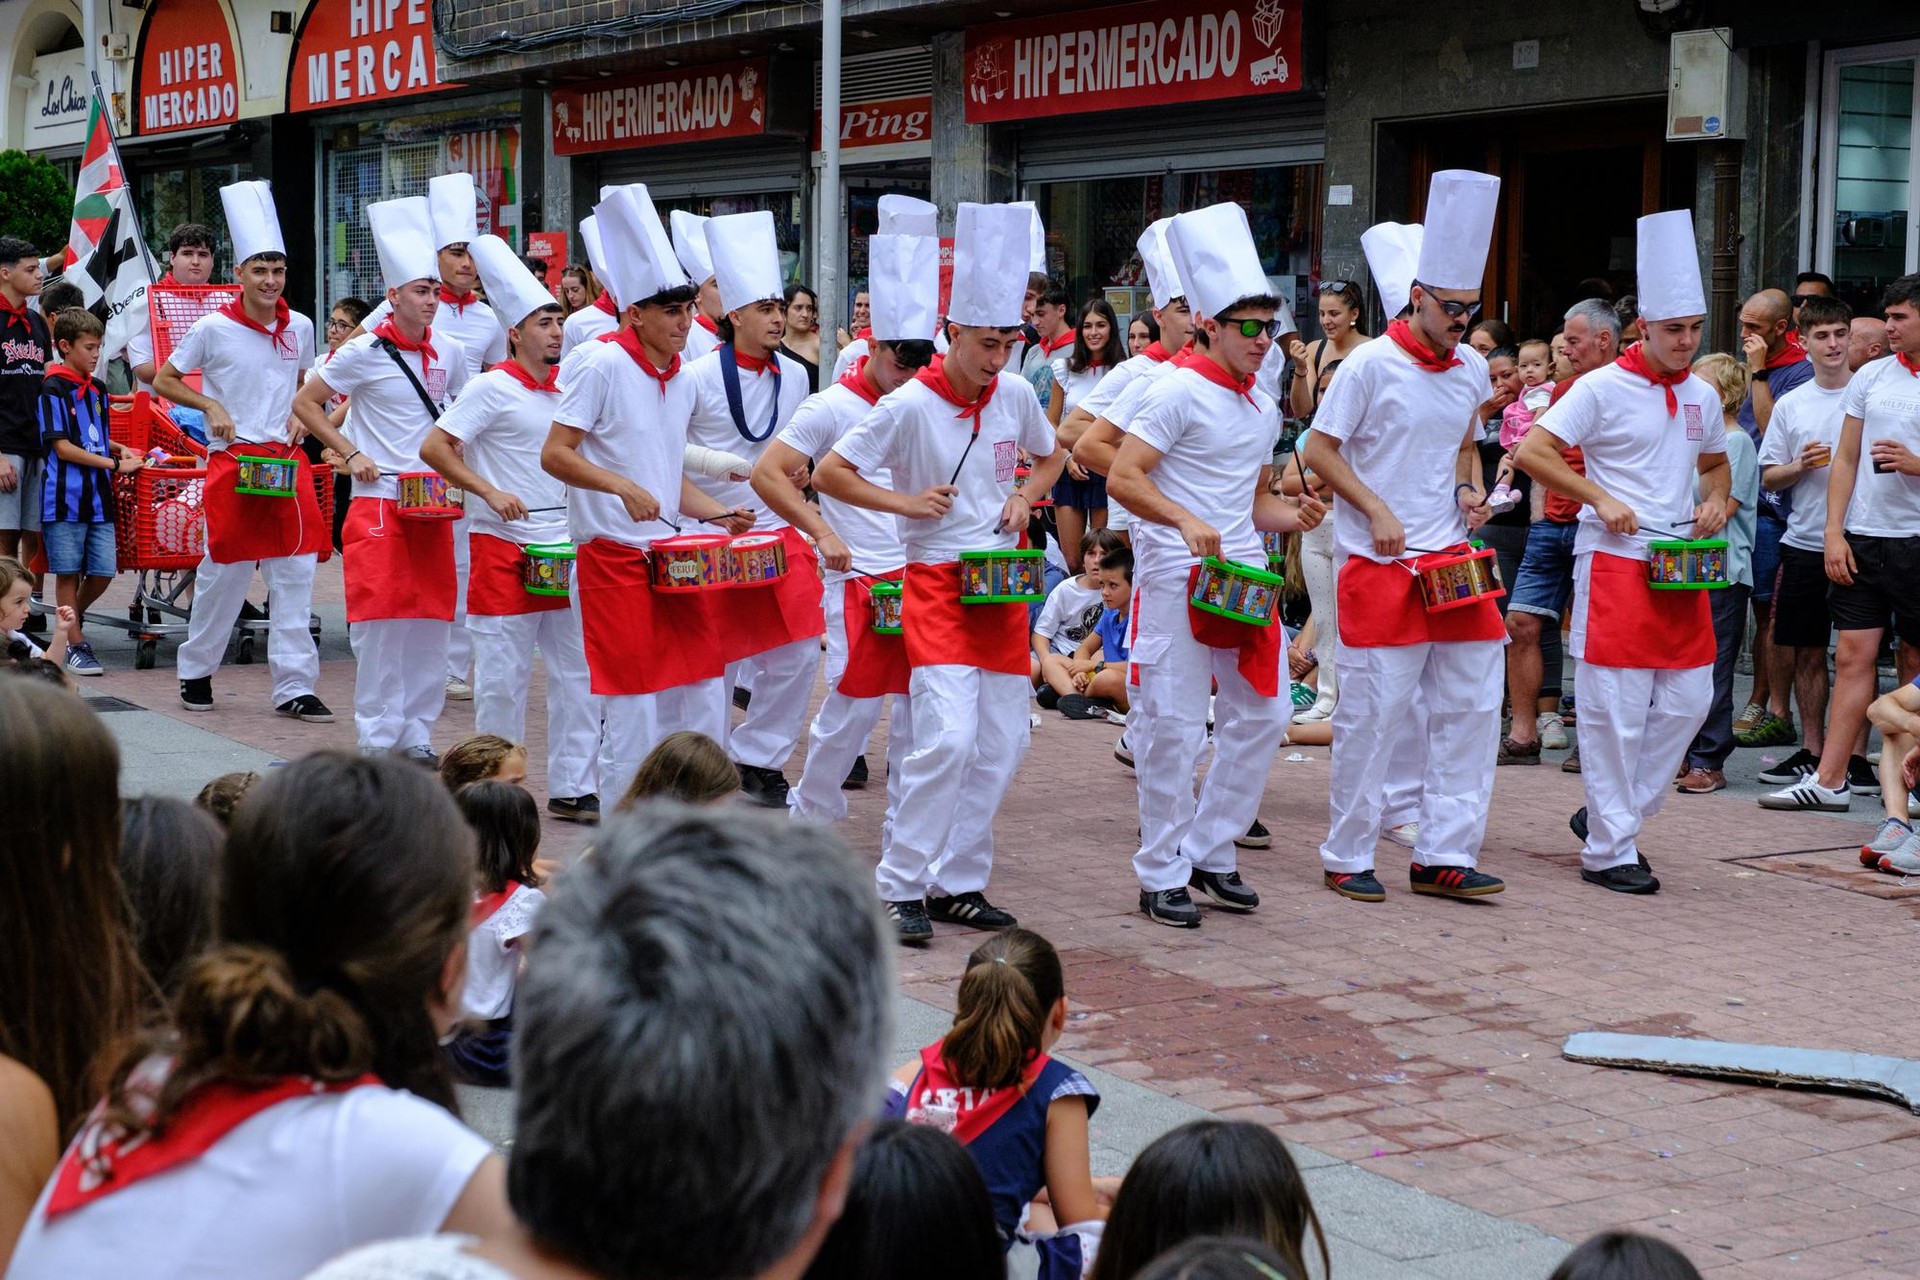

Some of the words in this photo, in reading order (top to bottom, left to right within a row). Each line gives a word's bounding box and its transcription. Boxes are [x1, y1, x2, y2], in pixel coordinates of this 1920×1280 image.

[159, 42, 223, 86] HIPER
[308, 35, 442, 104] MERCA
[1013, 9, 1241, 101] HIPERMERCADO
[42, 79, 60, 117] Los
[145, 82, 236, 130] MERCADO
[583, 73, 733, 142] HIPERMERCADO
[840, 108, 928, 140] Ping
